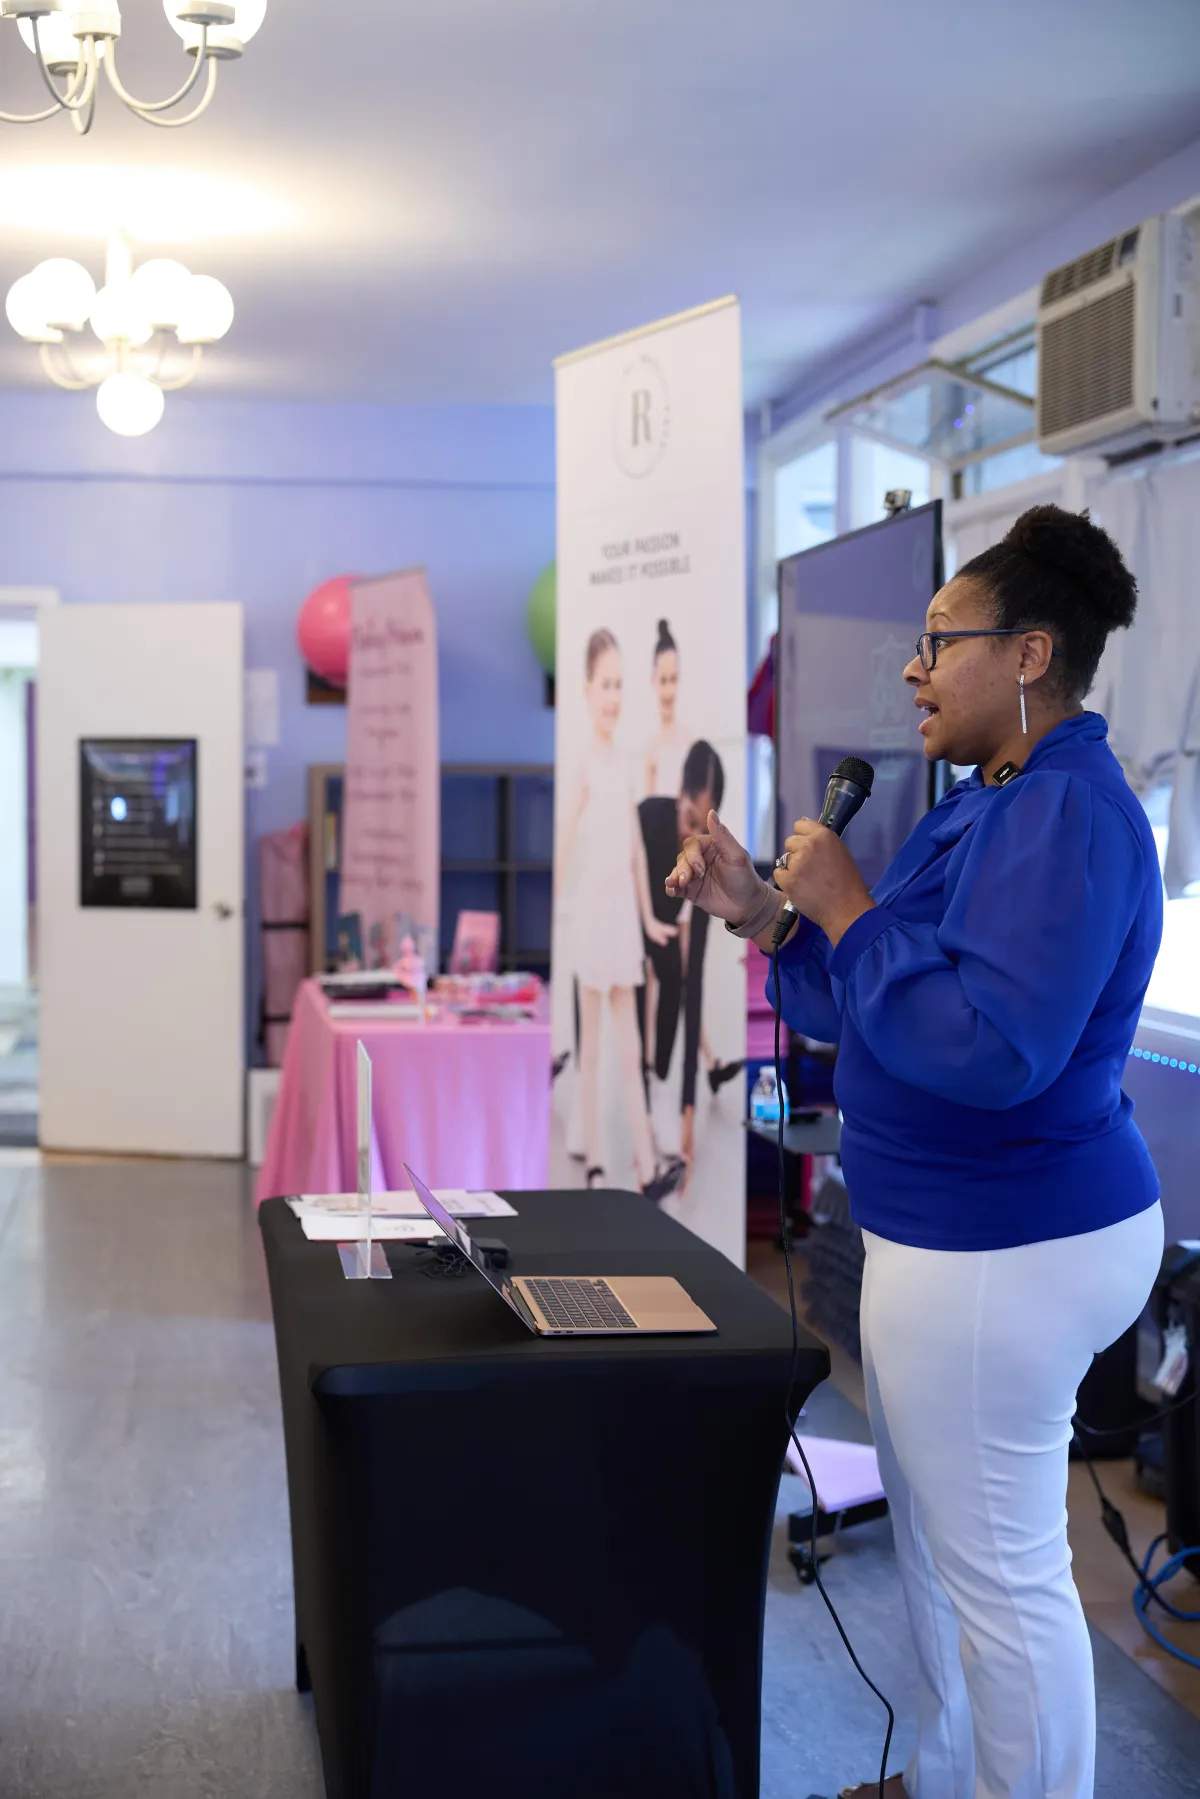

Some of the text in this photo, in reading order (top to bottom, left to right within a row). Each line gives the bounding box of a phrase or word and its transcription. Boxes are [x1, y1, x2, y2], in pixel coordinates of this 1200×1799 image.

[632, 388, 653, 447] R
[602, 532, 680, 560] YOUR PASSION
[642, 554, 691, 579] POSSIBLE
